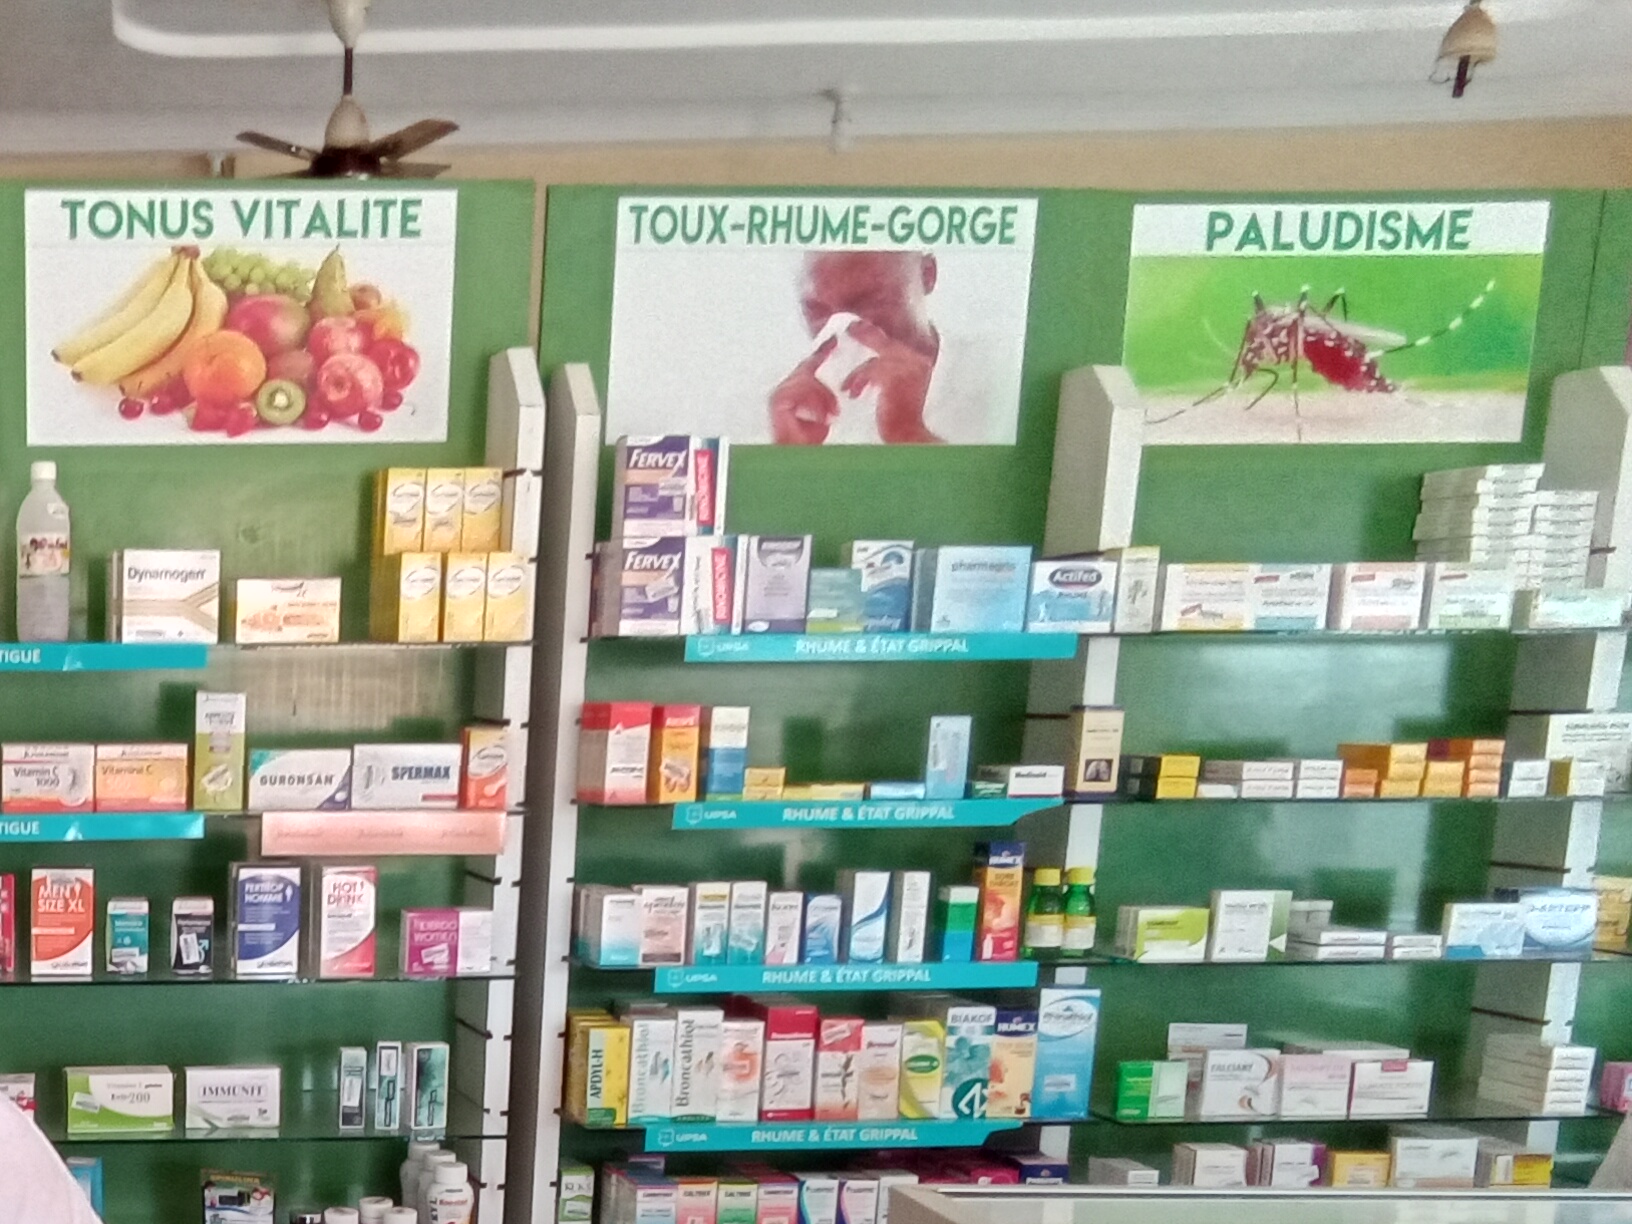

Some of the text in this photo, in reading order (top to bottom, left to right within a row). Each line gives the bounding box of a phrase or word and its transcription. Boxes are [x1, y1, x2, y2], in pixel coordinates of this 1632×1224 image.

[61, 198, 421, 240] TONUS VITALITE
[630, 204, 1018, 246] TOUX-RHUME-GORGE
[1205, 211, 1471, 251] PALUDISME
[629, 449, 687, 473] FERVEX
[625, 551, 682, 574] FERVEX
[1052, 569, 1097, 586] Actifed
[704, 802, 955, 822] UPSA RHUME & ÉTAT GRIPPAL
[38, 898, 86, 913] SIZE XL
[763, 968, 817, 985] RHUME
[821, 968, 834, 984] &
[837, 965, 871, 984] ÉTAT
[872, 967, 932, 984] GRIPPAL
[997, 1022, 1036, 1033] HUMEX
[589, 1048, 604, 1099] APDYL-H
[675, 1125, 918, 1143] UPSA RHUME & ÉTAT GRIPPAL
